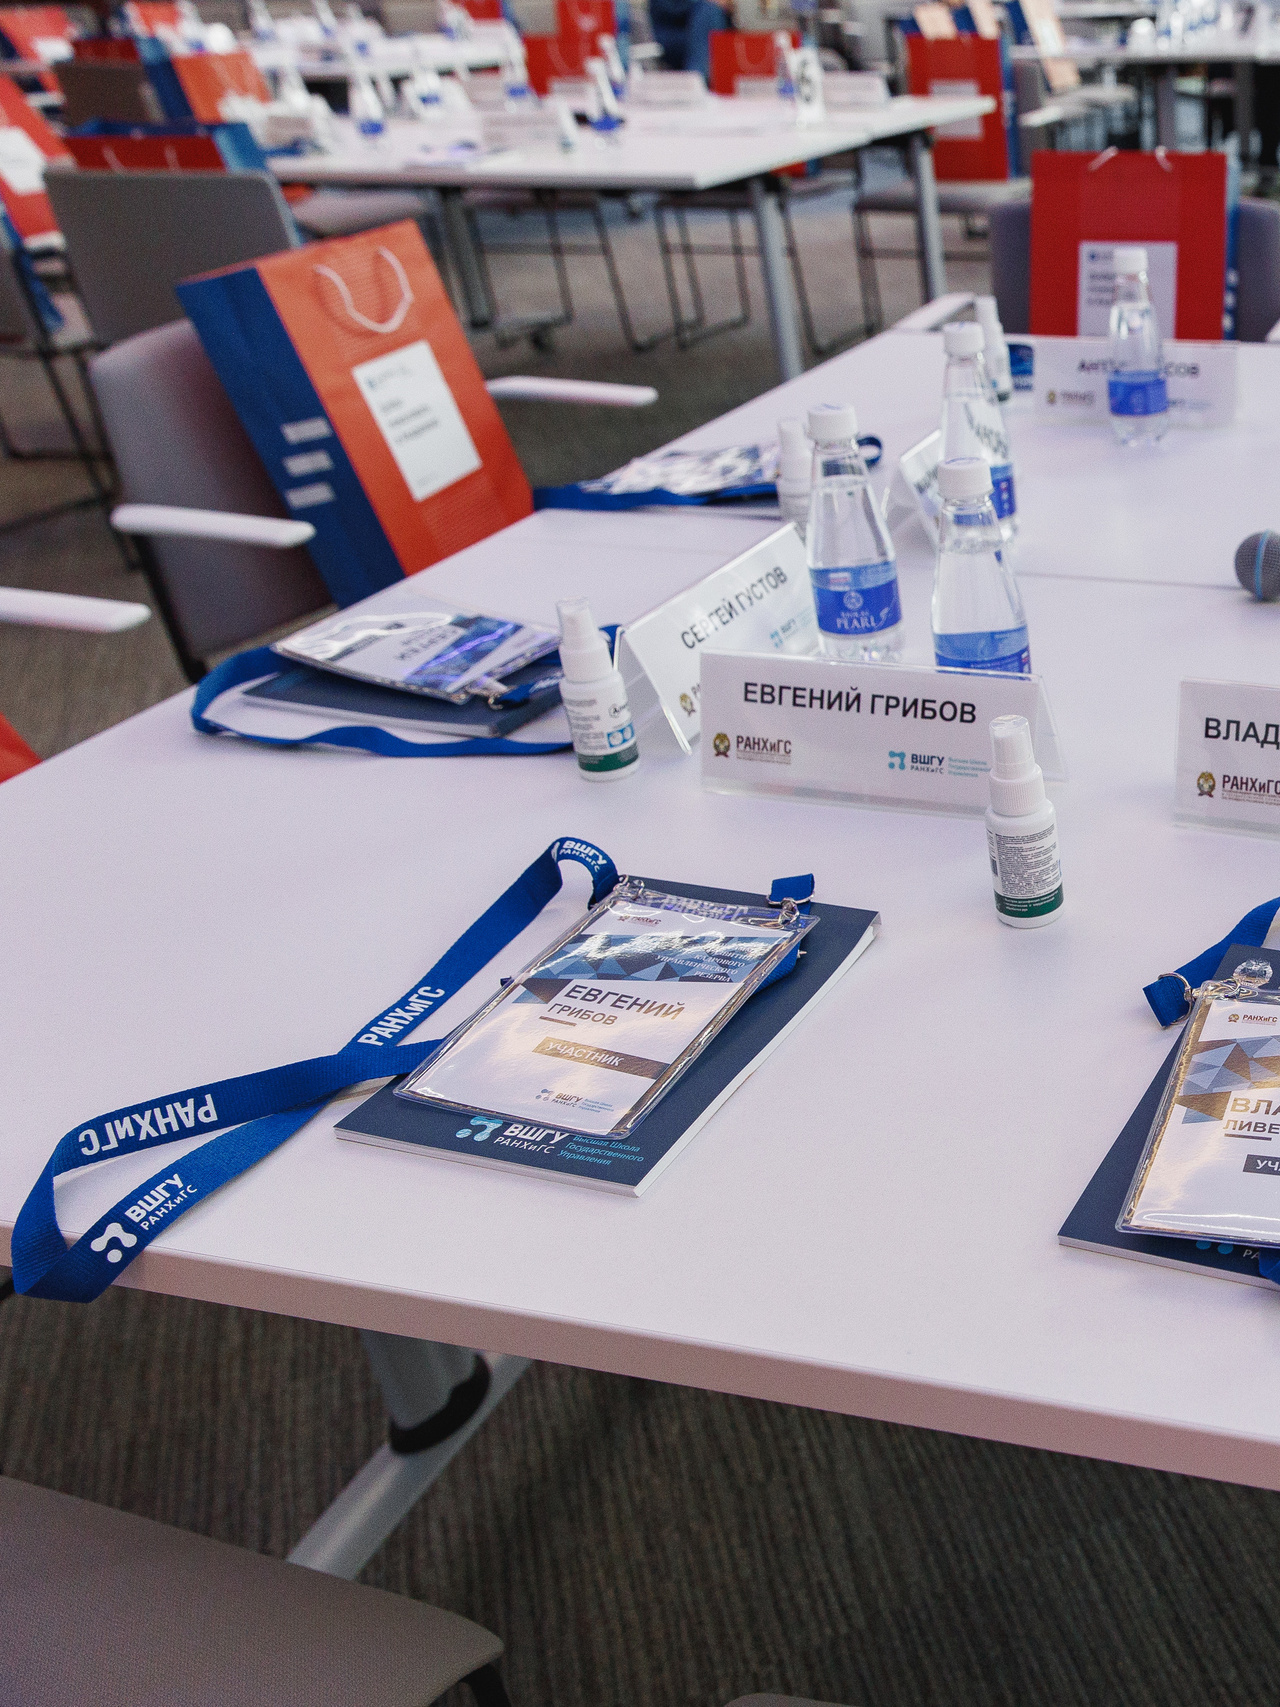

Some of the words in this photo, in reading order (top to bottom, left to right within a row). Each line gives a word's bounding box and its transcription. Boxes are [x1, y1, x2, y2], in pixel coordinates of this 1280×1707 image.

[681, 597, 739, 649] СЕРГЕЙ
[735, 566, 788, 613] ГУСТОВ
[744, 682, 862, 714] ЕВГЕНИЙ
[869, 693, 977, 724] ГРИБОВ
[736, 735, 792, 755] РАНХиГС
[911, 753, 945, 766] ВШГУ
[559, 849, 600, 873] РАНХиГС
[562, 840, 607, 865] ВШГУ
[564, 984, 685, 1020] ЕВГЕНИЙ
[357, 985, 445, 1046] РАНХиГС
[547, 1003, 618, 1026] ГРИБОВ
[1242, 1014, 1278, 1023] РАНХиГС
[545, 1042, 625, 1067] УЧАСТНИК
[555, 1092, 583, 1103] ВШГУ
[78, 1093, 219, 1156] РАНХиГС
[503, 1123, 570, 1144] ВШГУ
[493, 1136, 556, 1154] РАНХиГС
[565, 1142, 645, 1162] Государственного
[609, 1141, 641, 1152] Школа
[557, 1151, 612, 1166] Управления
[125, 1173, 185, 1224] ВШГУ
[140, 1184, 198, 1231] РАНХиГС
